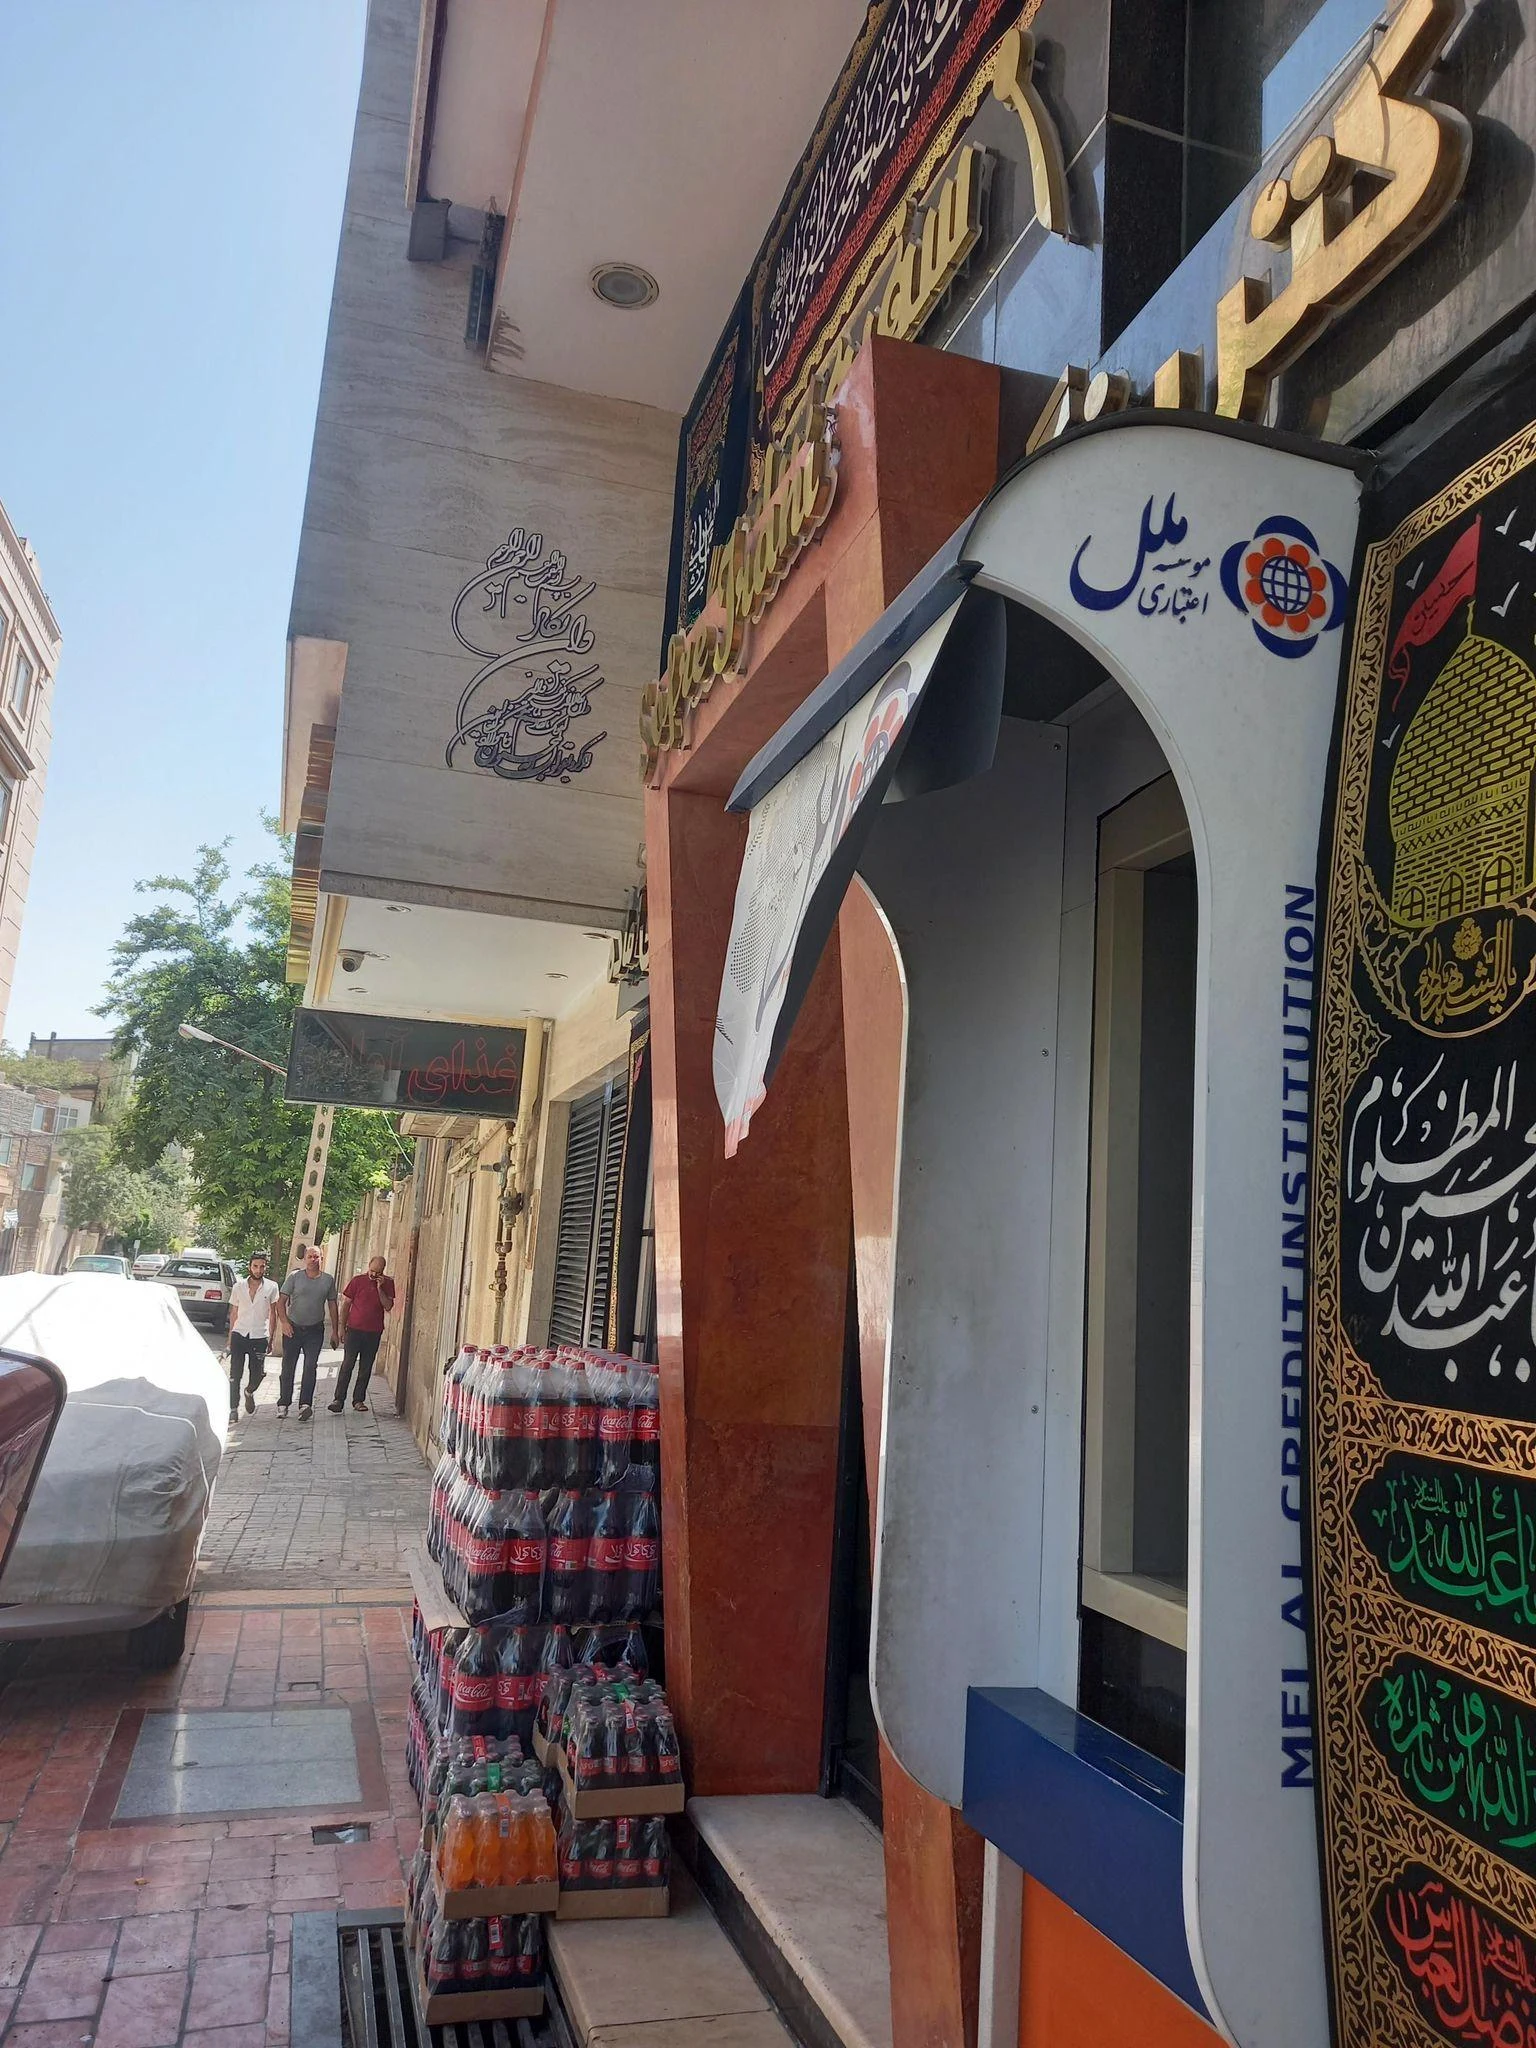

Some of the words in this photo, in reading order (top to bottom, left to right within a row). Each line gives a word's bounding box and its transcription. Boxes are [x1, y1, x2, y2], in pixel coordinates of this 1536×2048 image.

[1070, 492, 1188, 611] ملل
[1152, 557, 1211, 578] موسسه
[1138, 583, 1209, 624] اعتباری
[407, 1036, 519, 1106] غذای
